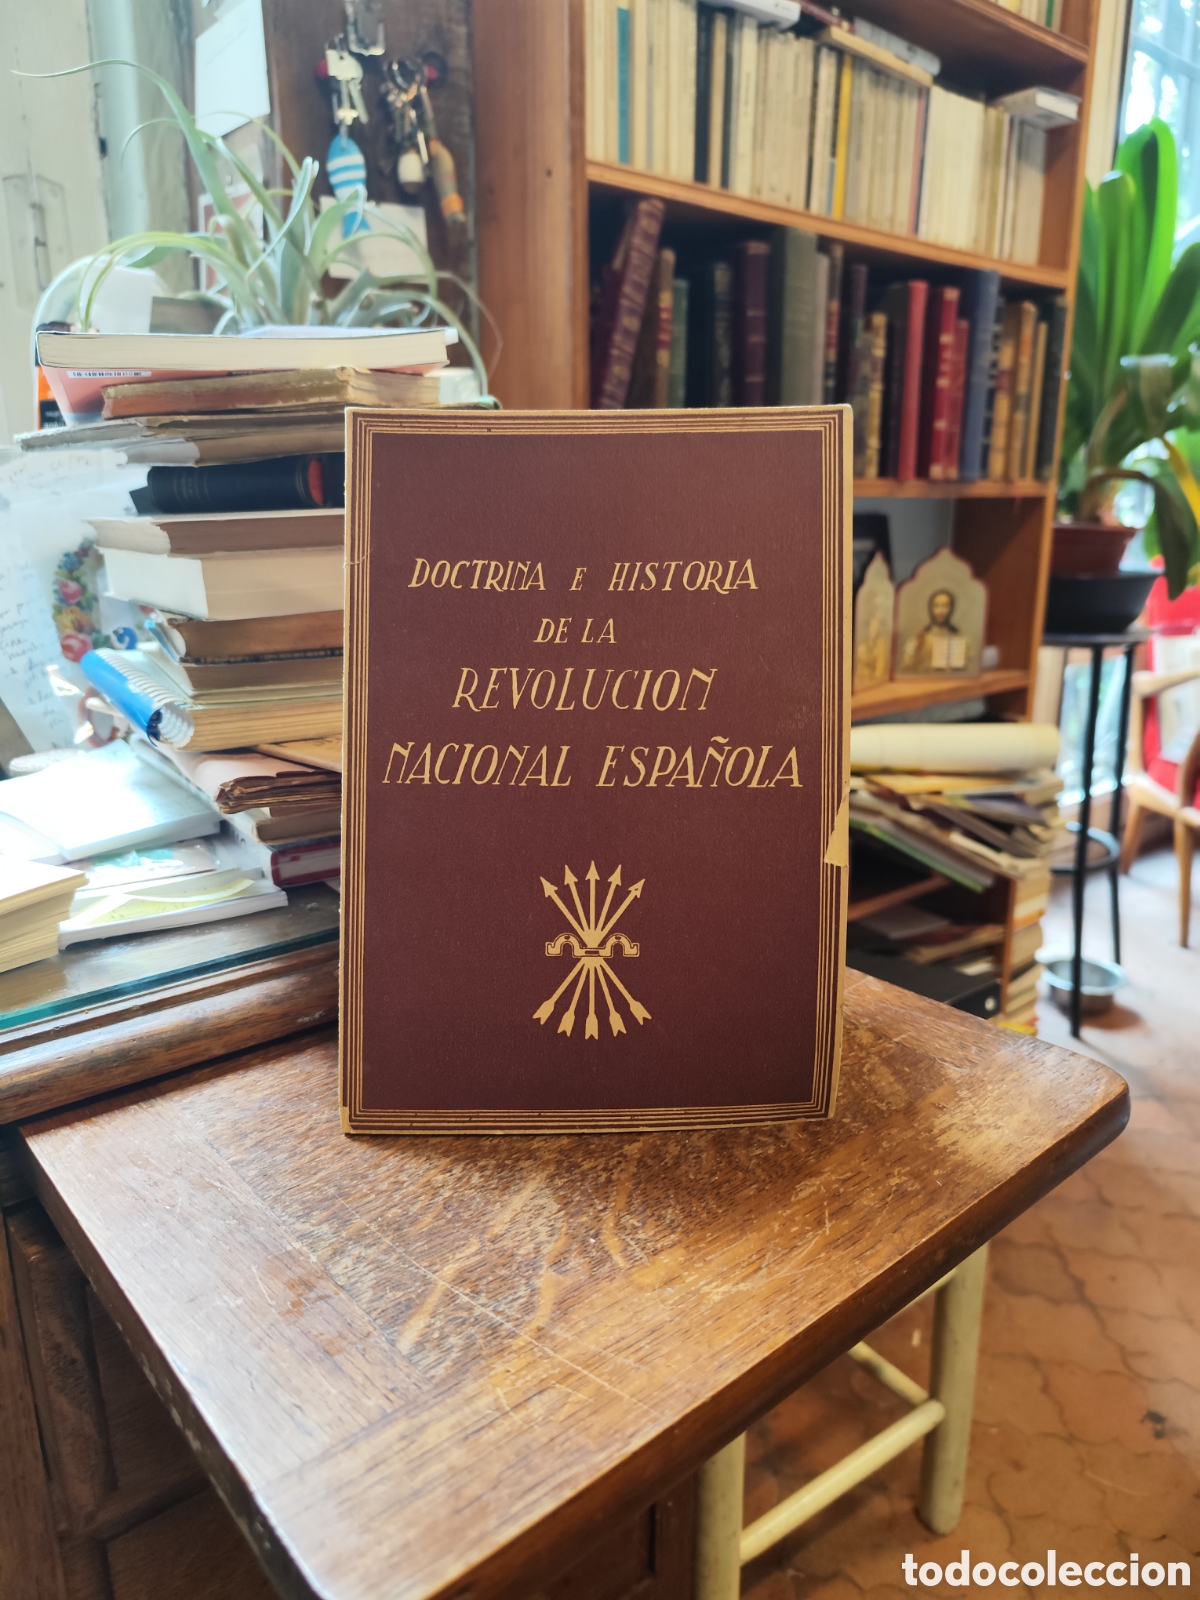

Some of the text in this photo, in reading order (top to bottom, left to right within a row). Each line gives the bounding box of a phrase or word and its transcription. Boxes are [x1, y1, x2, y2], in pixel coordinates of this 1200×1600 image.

[407, 557, 759, 595] DOCTRINA E HISTORIA
[533, 617, 617, 645] DE LA
[451, 667, 718, 712] REVOLUCION
[382, 735, 803, 789] NACIONAL ESPAÑOLA
